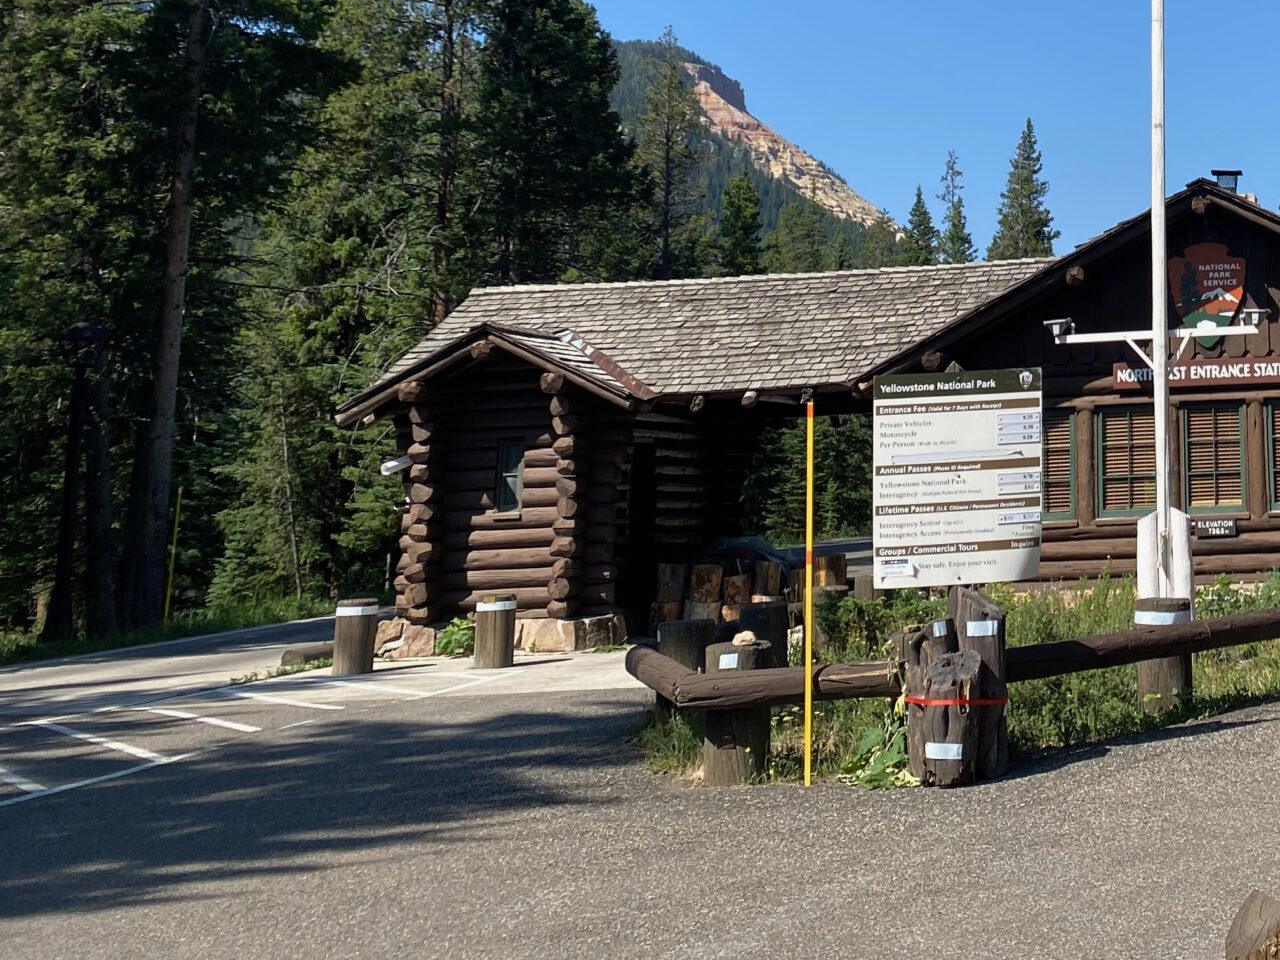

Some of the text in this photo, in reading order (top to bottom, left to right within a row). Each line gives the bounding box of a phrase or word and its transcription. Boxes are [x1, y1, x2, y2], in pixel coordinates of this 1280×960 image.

[1117, 366, 1187, 383] NORTHAST
[1190, 363, 1250, 379] ENTRANCE
[880, 379, 996, 393] Yellowstone National Park
[880, 406, 912, 414] Entrance
[880, 431, 917, 439] Motorcycle
[880, 466, 906, 474] Annual
[880, 481, 920, 489] Yellowstone
[921, 479, 950, 487] National
[879, 506, 909, 515] Lifetime
[880, 522, 918, 530] Interagency
[1197, 520, 1233, 528] ELEVATION
[880, 532, 918, 540] Interagency
[1011, 541, 1035, 549] Inquire
[879, 548, 905, 557] Groups
[913, 545, 956, 554] Commercial
[949, 560, 966, 568] Enjoy
